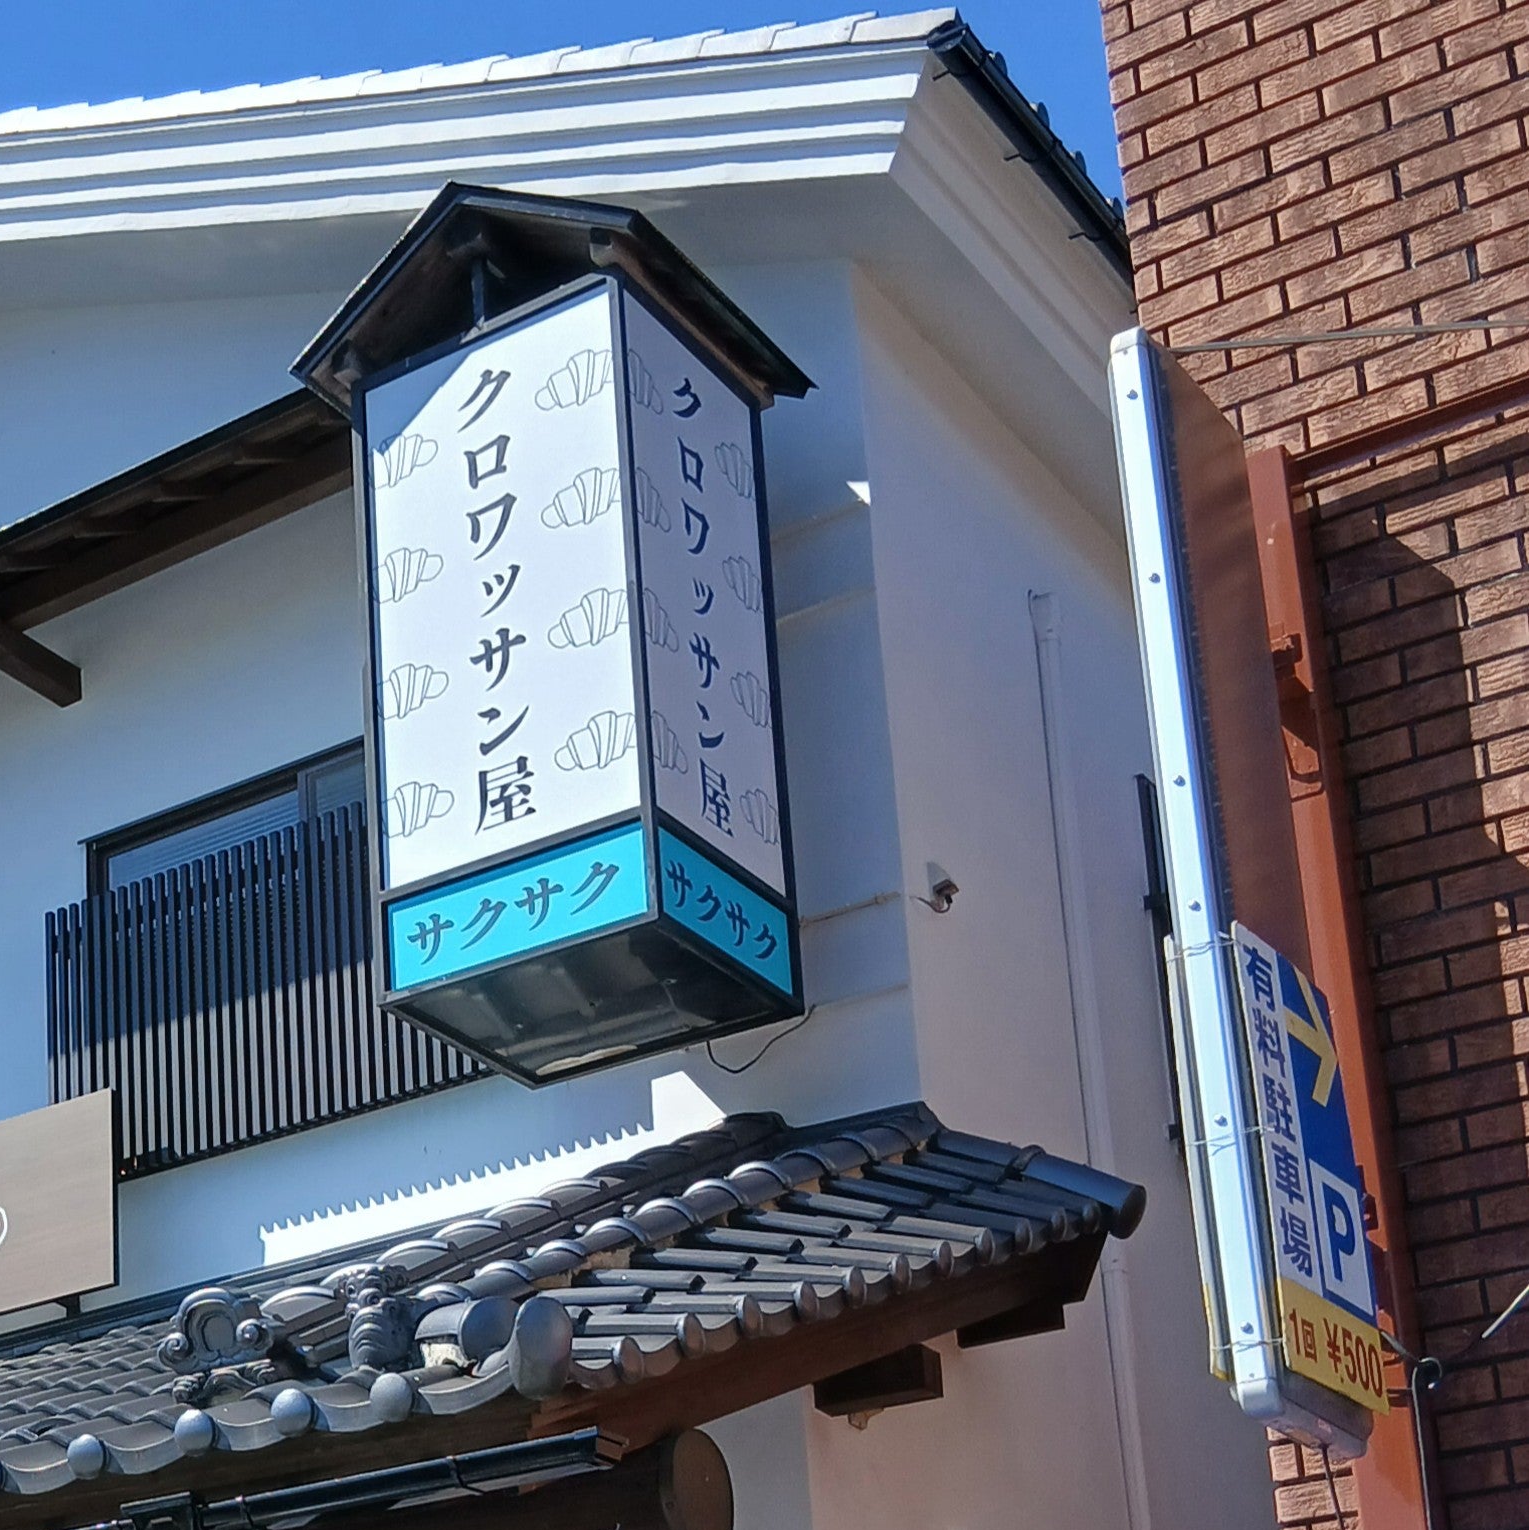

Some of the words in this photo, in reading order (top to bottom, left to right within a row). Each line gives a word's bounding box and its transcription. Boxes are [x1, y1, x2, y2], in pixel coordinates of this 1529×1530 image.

[457, 369, 536, 836] クロワッサン屋
[672, 377, 735, 838] クロワッサン屋
[406, 861, 620, 966] サクサク
[665, 861, 779, 963] サクサク
[1243, 946, 1314, 1279] 有料駐車場
[1325, 1182, 1357, 1282] P
[1288, 1307, 1317, 1362] 1回
[1323, 1316, 1383, 1398] ¥500
